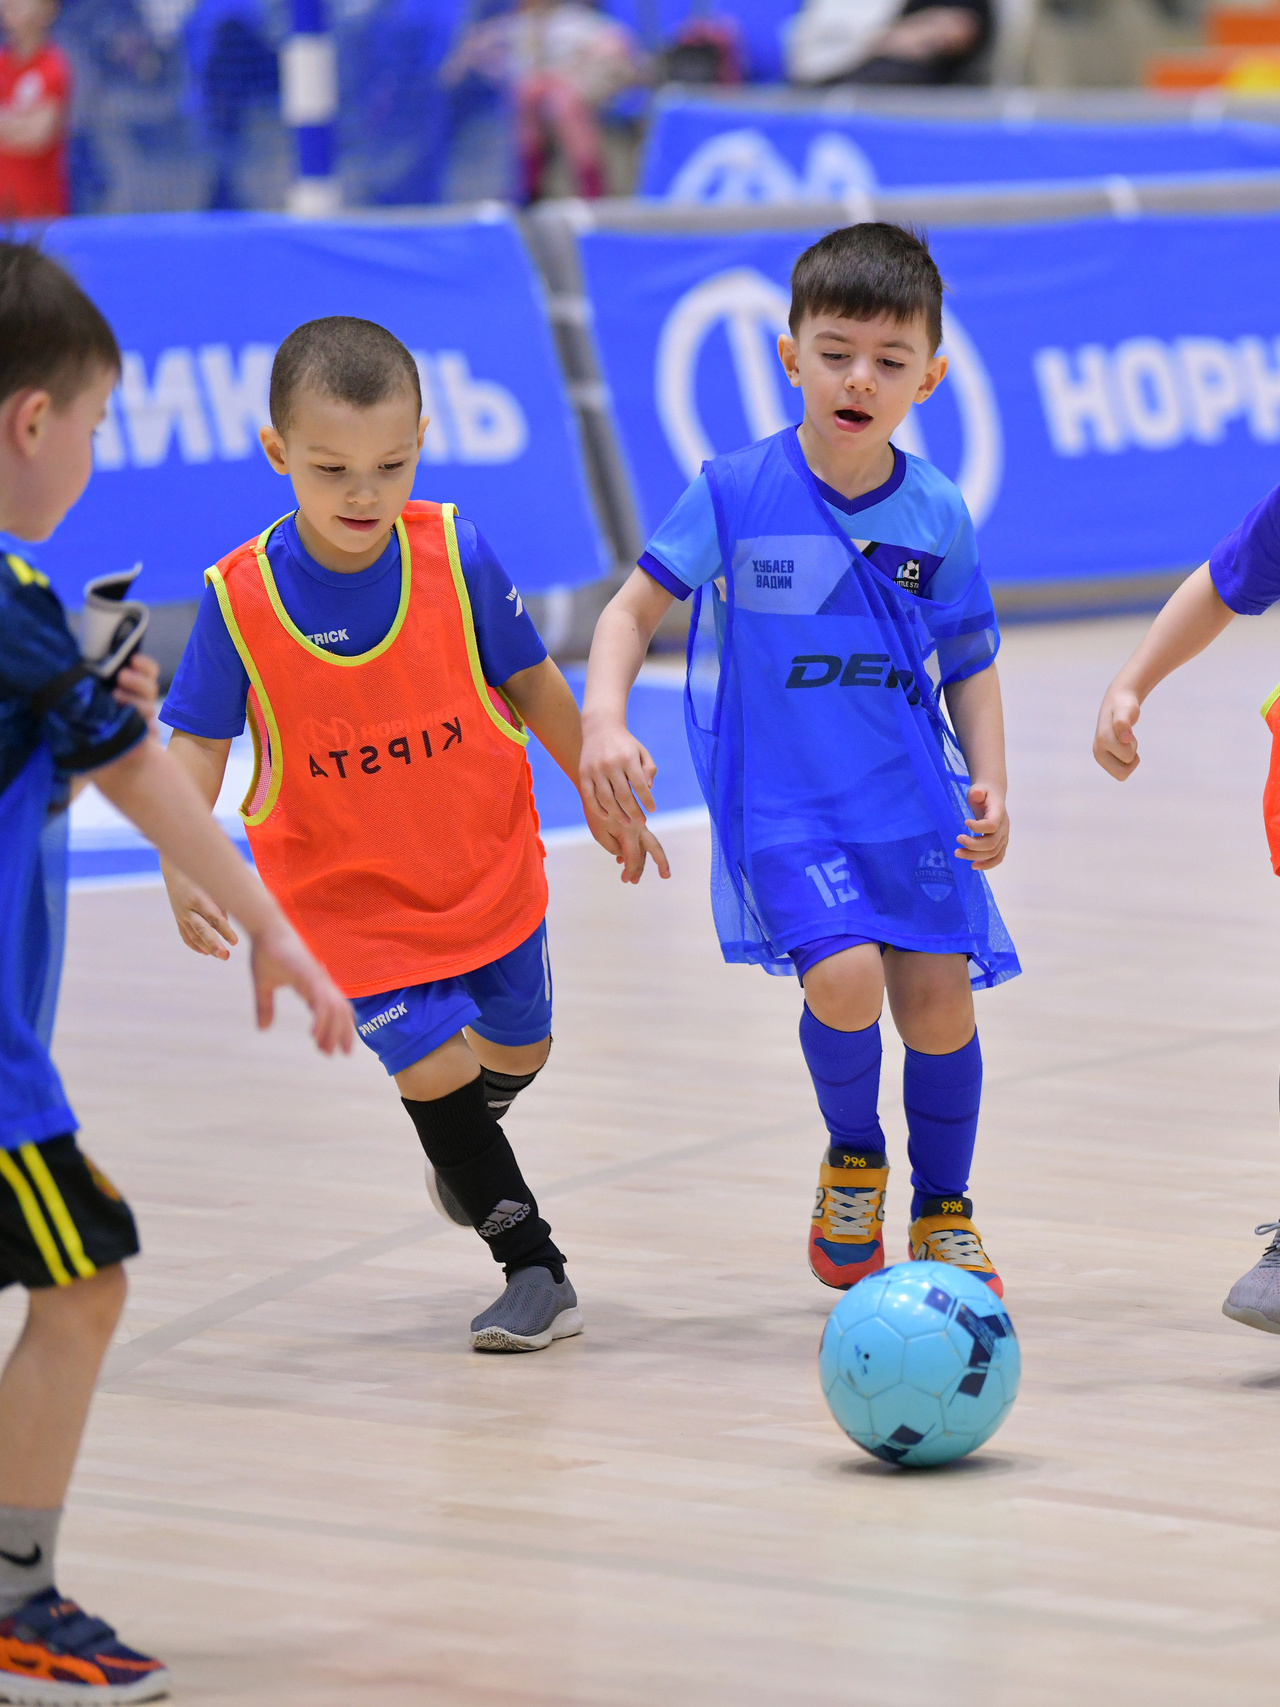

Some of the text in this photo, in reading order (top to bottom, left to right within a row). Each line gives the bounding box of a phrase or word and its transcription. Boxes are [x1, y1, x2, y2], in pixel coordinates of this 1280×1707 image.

[752, 560, 795, 574] ХУБАЕВ
[756, 575, 793, 590] ВАДИМ
[804, 856, 860, 909] 15
[842, 1155, 867, 1168] 996
[941, 1200, 964, 1214] 996
[478, 1203, 531, 1237] adidas
